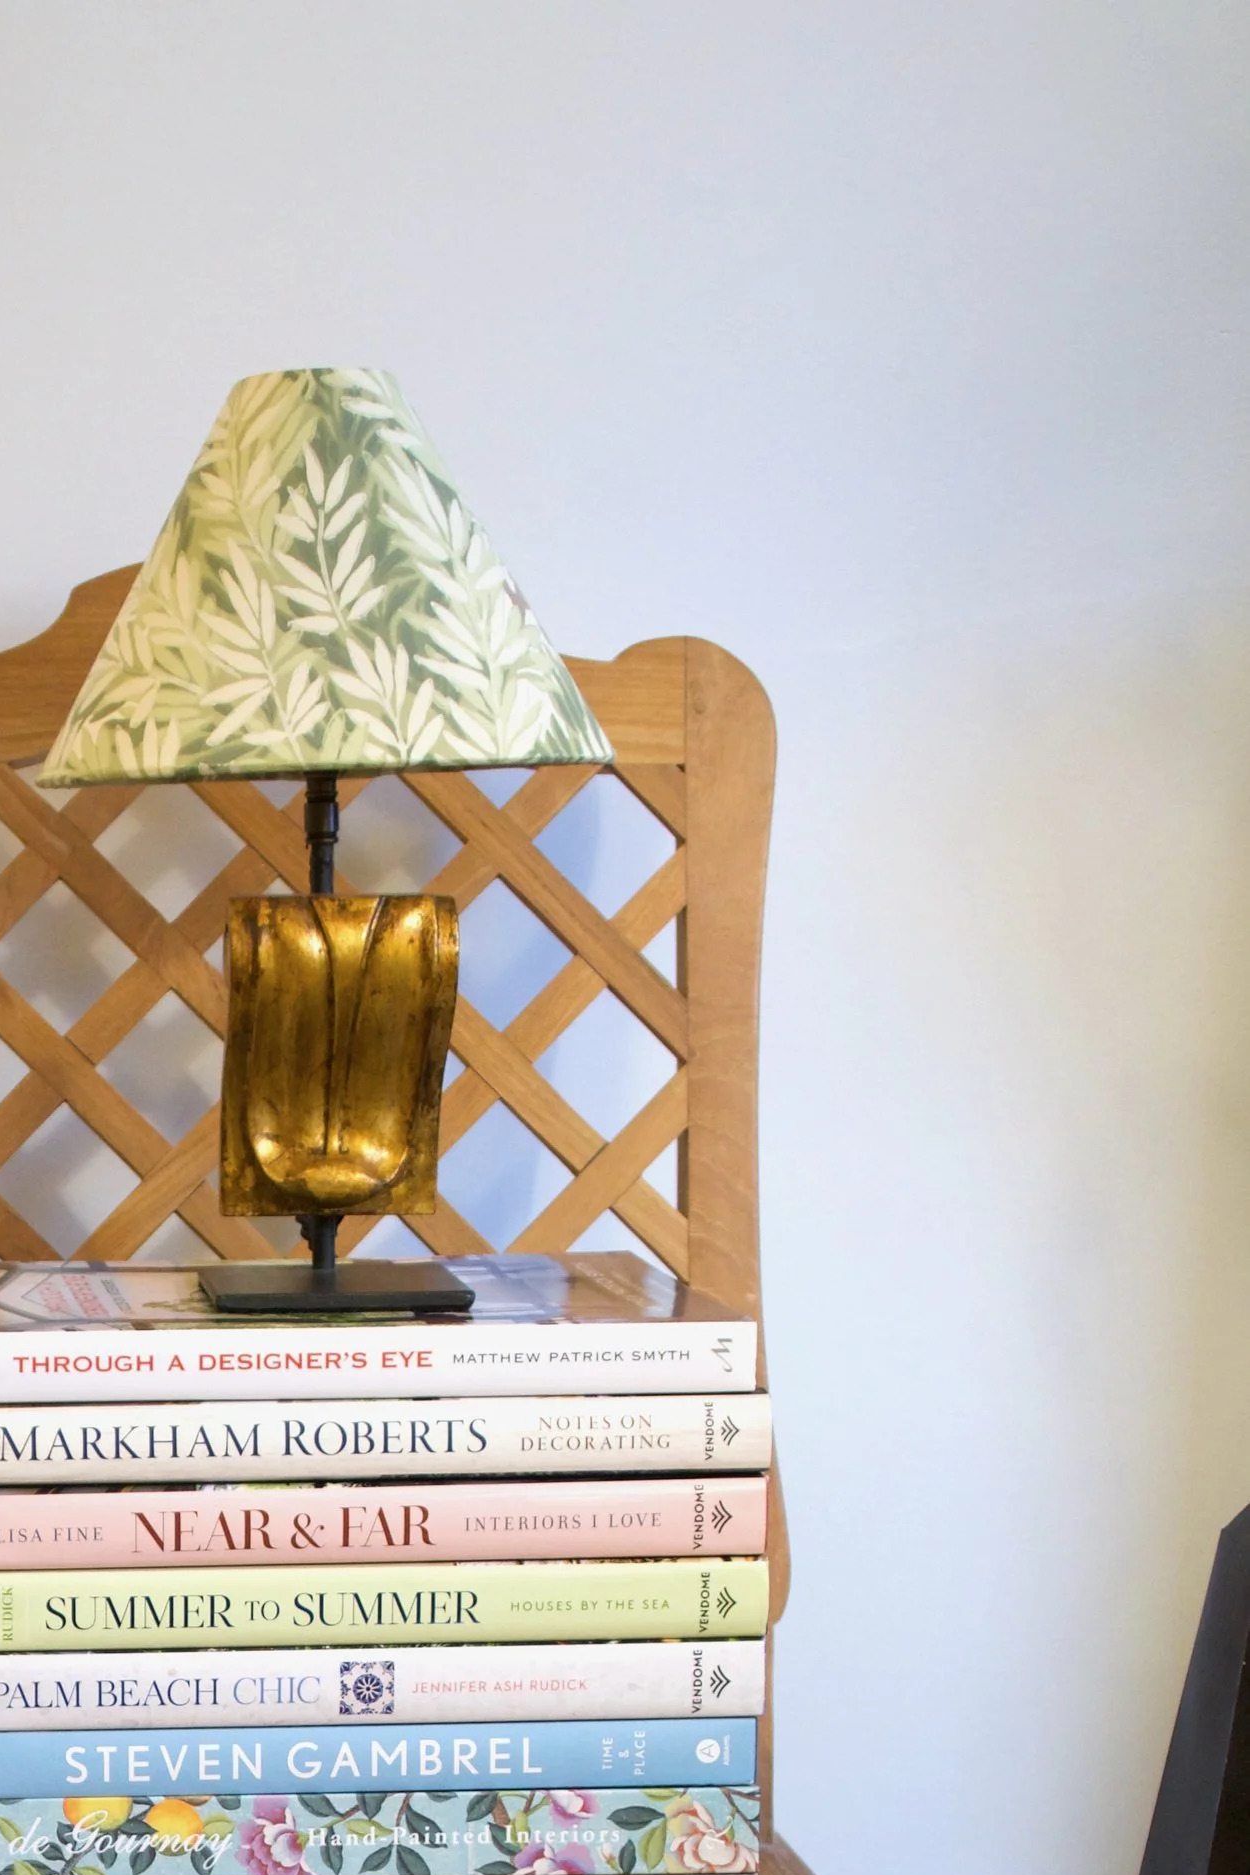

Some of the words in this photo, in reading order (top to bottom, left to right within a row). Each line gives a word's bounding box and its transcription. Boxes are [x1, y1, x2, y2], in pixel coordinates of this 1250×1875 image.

[13, 1355, 154, 1373] THROUGH
[167, 1356, 186, 1372] A
[381, 1350, 433, 1368] EYE
[452, 1352, 540, 1364] MATTHEW
[549, 1350, 625, 1363] PATRICK
[631, 1349, 691, 1361] SMYTH
[281, 1417, 488, 1457] ROBERTS
[538, 1415, 612, 1431] NOTES
[620, 1414, 653, 1429] ON
[704, 1401, 714, 1461] VENDOME
[520, 1434, 672, 1453] DECORATING
[52, 1526, 104, 1542] FINE
[130, 1508, 278, 1554] NEAR
[290, 1512, 327, 1550] &
[339, 1504, 437, 1549] FAR
[464, 1514, 582, 1532] INTERIORS
[591, 1514, 598, 1529] I
[608, 1511, 662, 1528] LOVE
[692, 1484, 705, 1550] VENDOME
[1, 1586, 14, 1642] RUDICK
[44, 1594, 235, 1632] SUMMER
[244, 1599, 281, 1622] TO
[292, 1590, 481, 1627] SUMMER
[510, 1600, 573, 1612] HOUSES
[580, 1600, 599, 1611] BY
[606, 1599, 635, 1611] THE
[640, 1599, 671, 1610] SEA
[699, 1571, 711, 1633] VENDOME
[95, 1677, 218, 1708] BEACH
[232, 1675, 322, 1705] CHIC
[412, 1680, 488, 1694] JENNIFER
[493, 1679, 524, 1692] ASH
[529, 1678, 589, 1692] RUDICK
[691, 1649, 703, 1714] VENDOME
[64, 1743, 262, 1784] STEVEN
[286, 1736, 544, 1780] GAMBREL
[602, 1736, 614, 1770] TIME
[634, 1729, 646, 1776] PLACE
[7, 1817, 50, 1857] de
[62, 1809, 235, 1869] Gournay
[307, 1825, 492, 1849] Hand-Painted
[504, 1824, 622, 1845] Interiors
